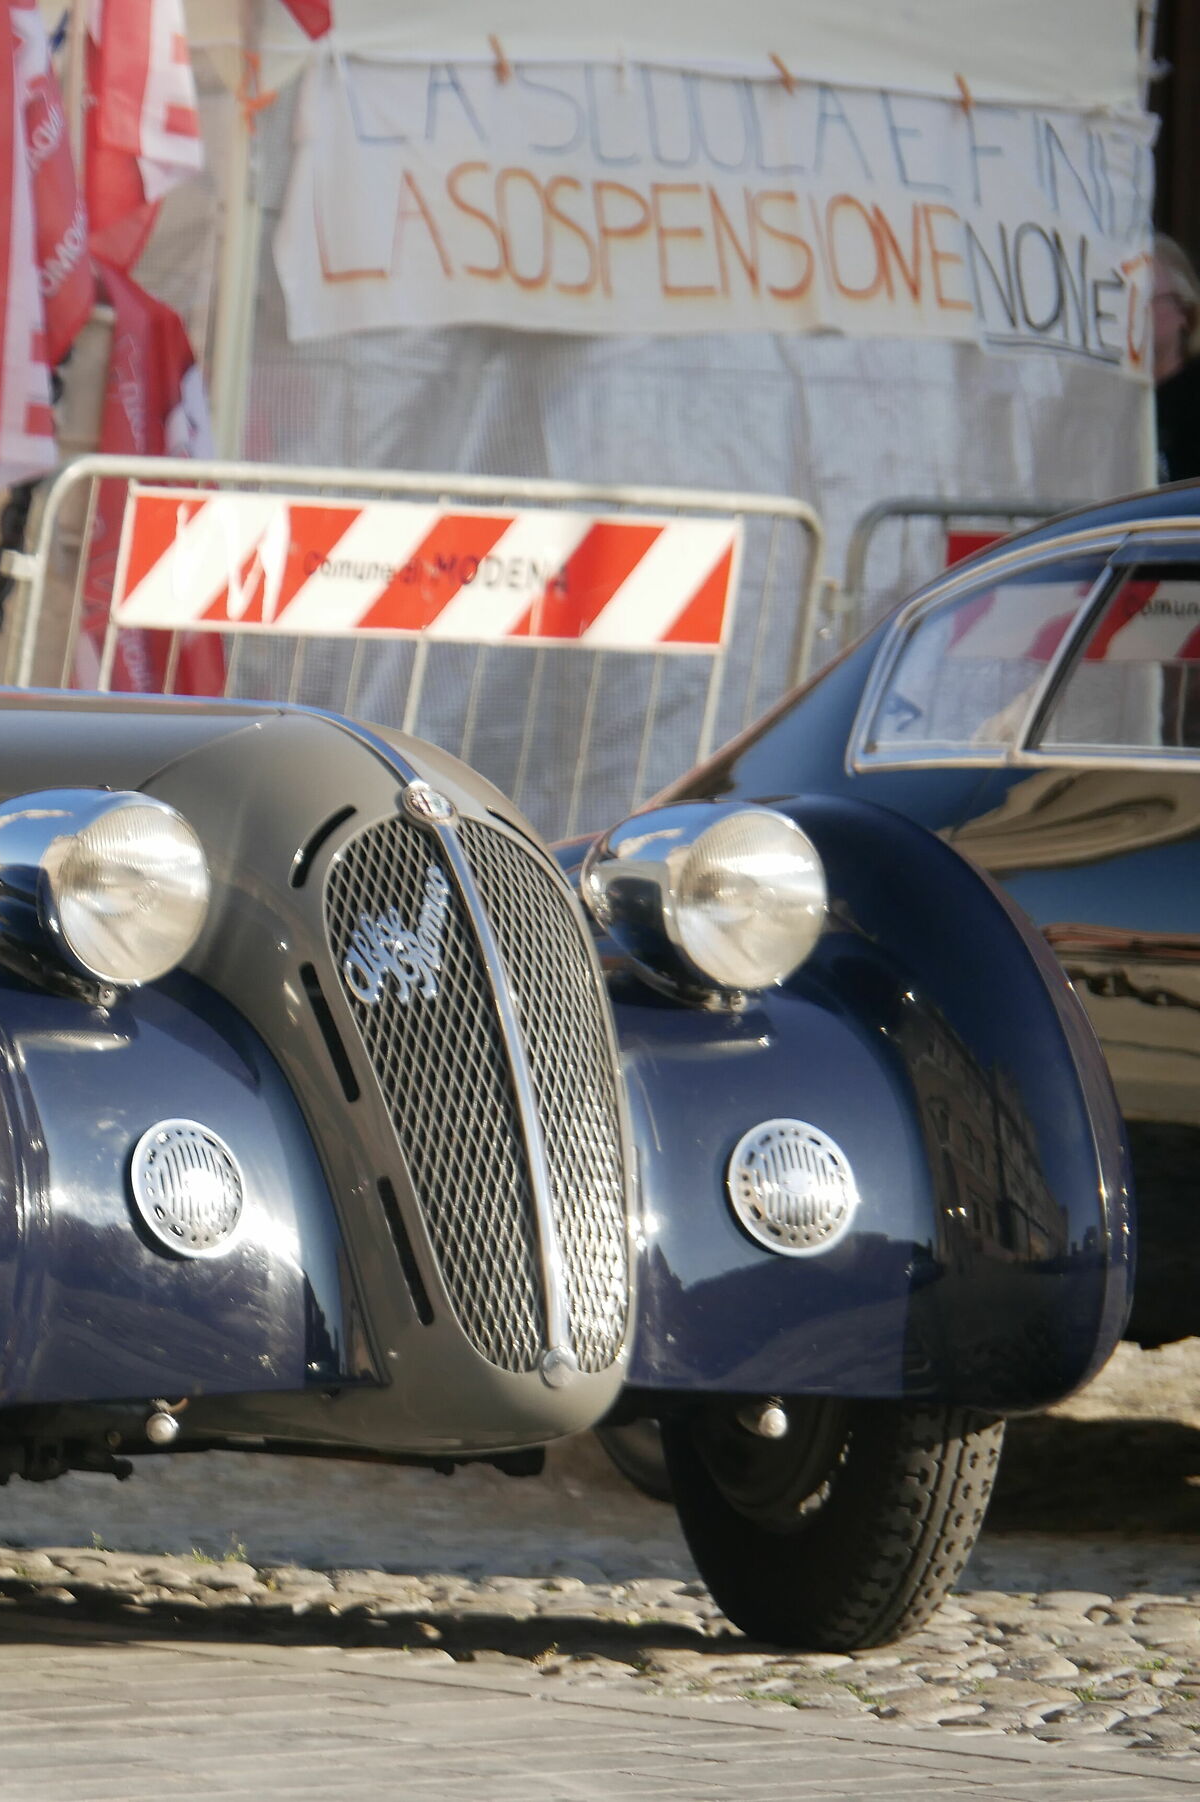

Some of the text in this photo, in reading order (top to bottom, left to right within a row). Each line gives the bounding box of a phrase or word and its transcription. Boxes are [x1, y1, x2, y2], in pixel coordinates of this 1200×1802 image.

[303, 550, 395, 584] Comune
[433, 552, 570, 592] MODENA
[1124, 593, 1200, 618] Comun
